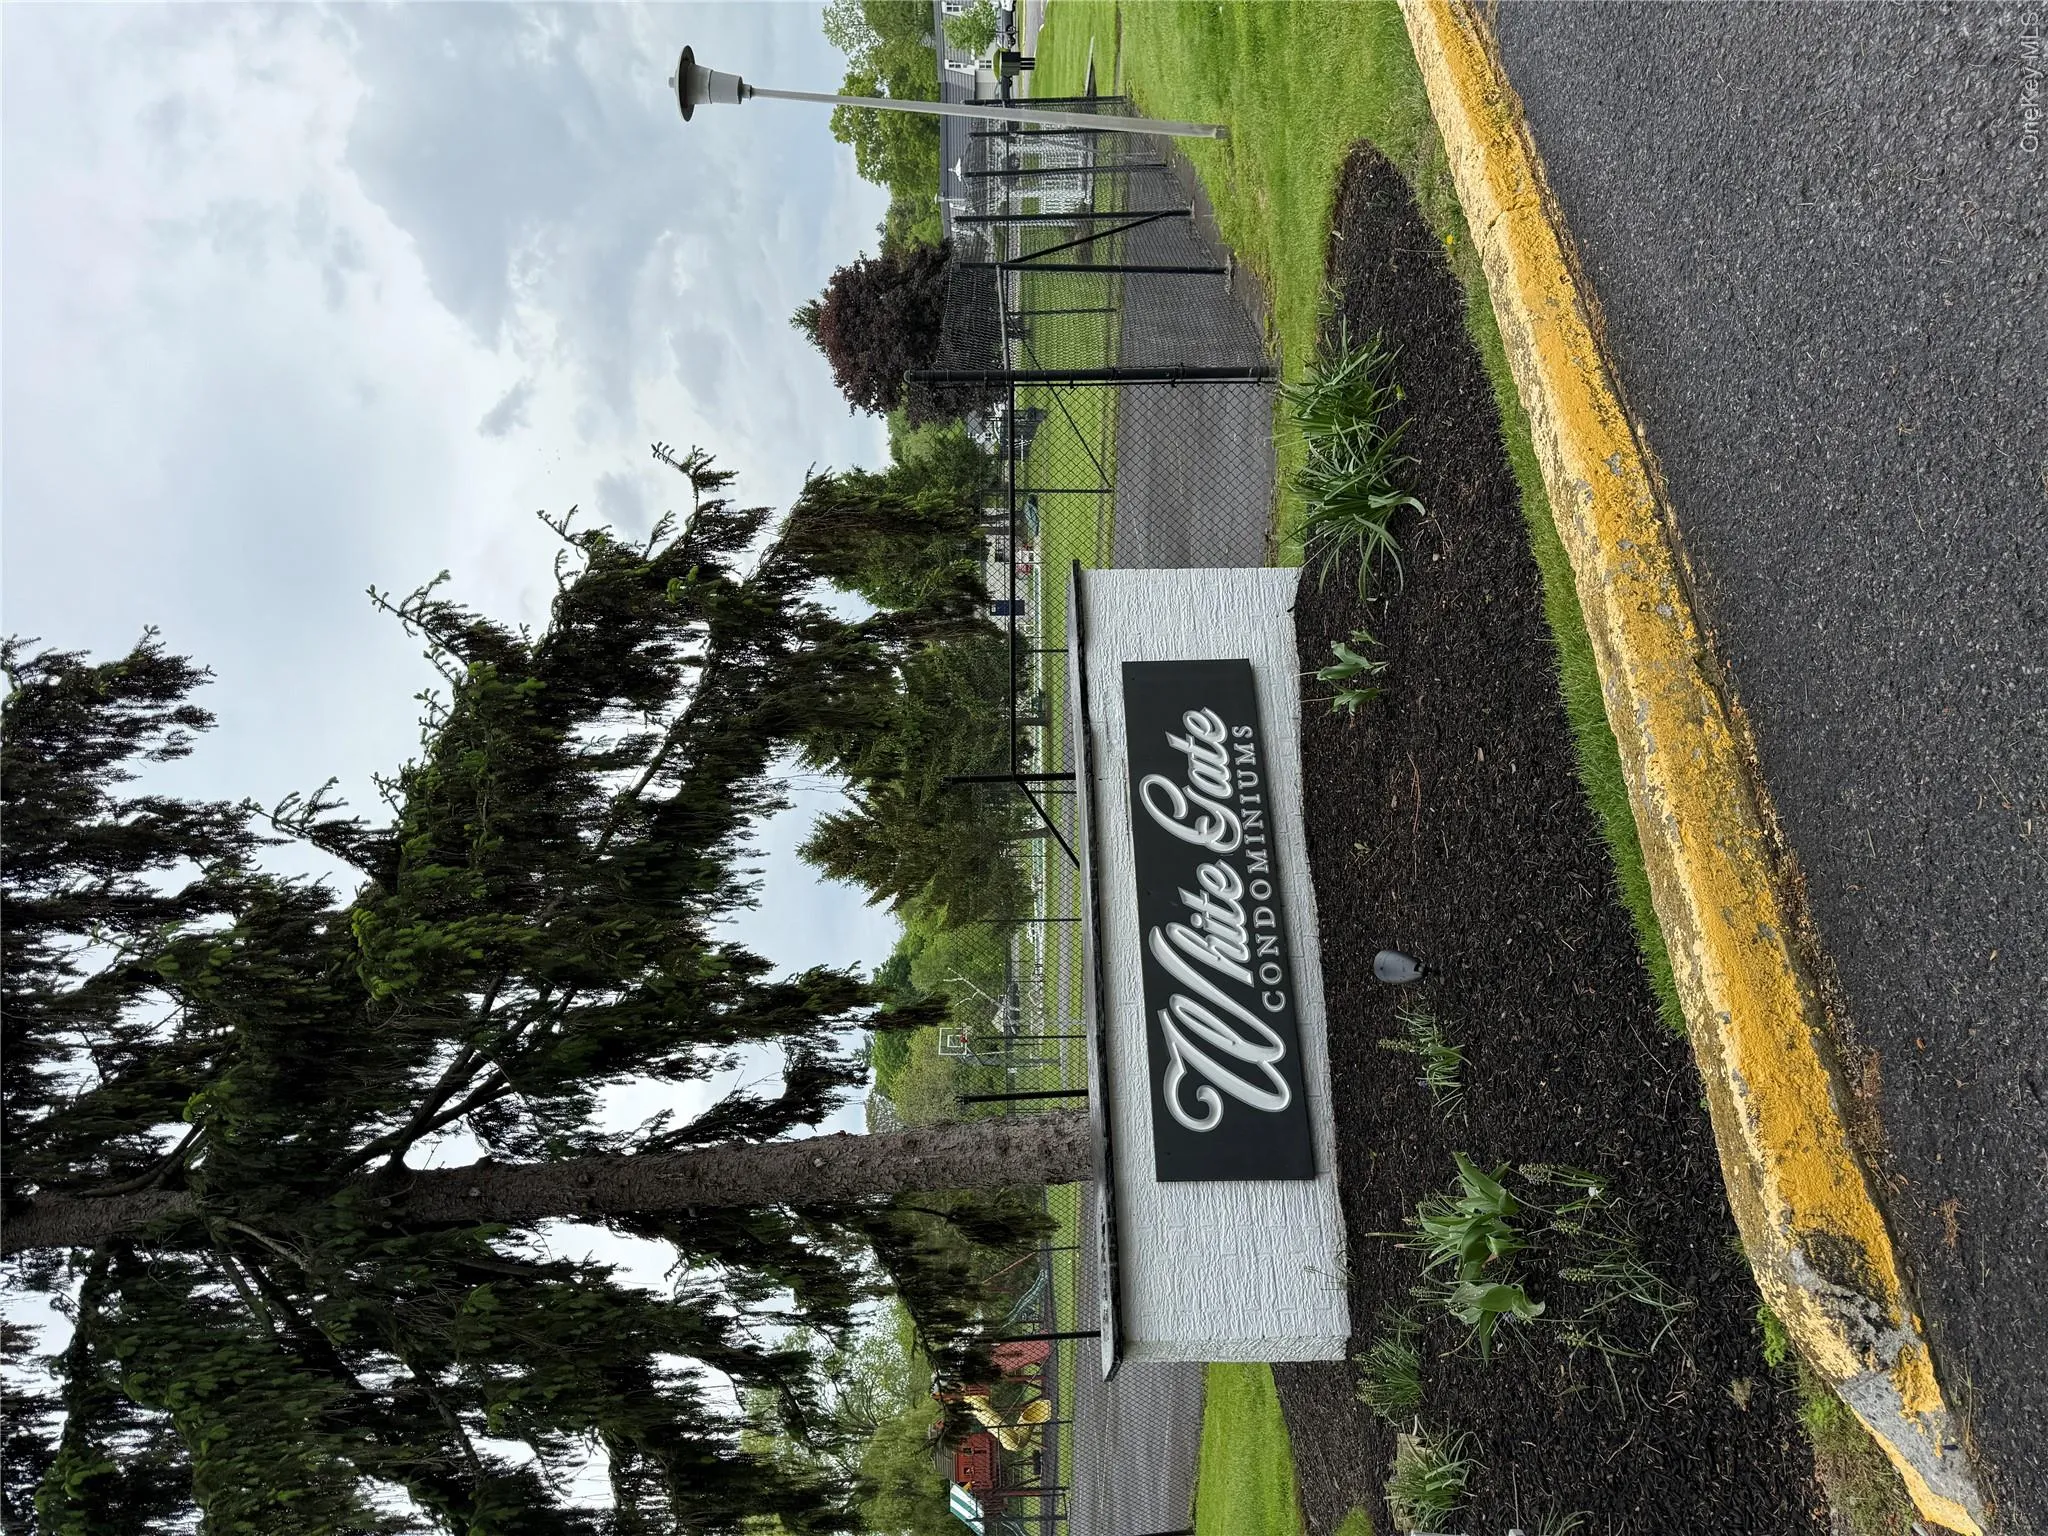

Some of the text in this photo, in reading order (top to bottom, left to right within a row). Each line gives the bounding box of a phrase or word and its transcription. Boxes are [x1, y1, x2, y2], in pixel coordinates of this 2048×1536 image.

[1138, 706, 1292, 1133] White Gate
[1231, 723, 1287, 1014] CONDOMINIUMS
